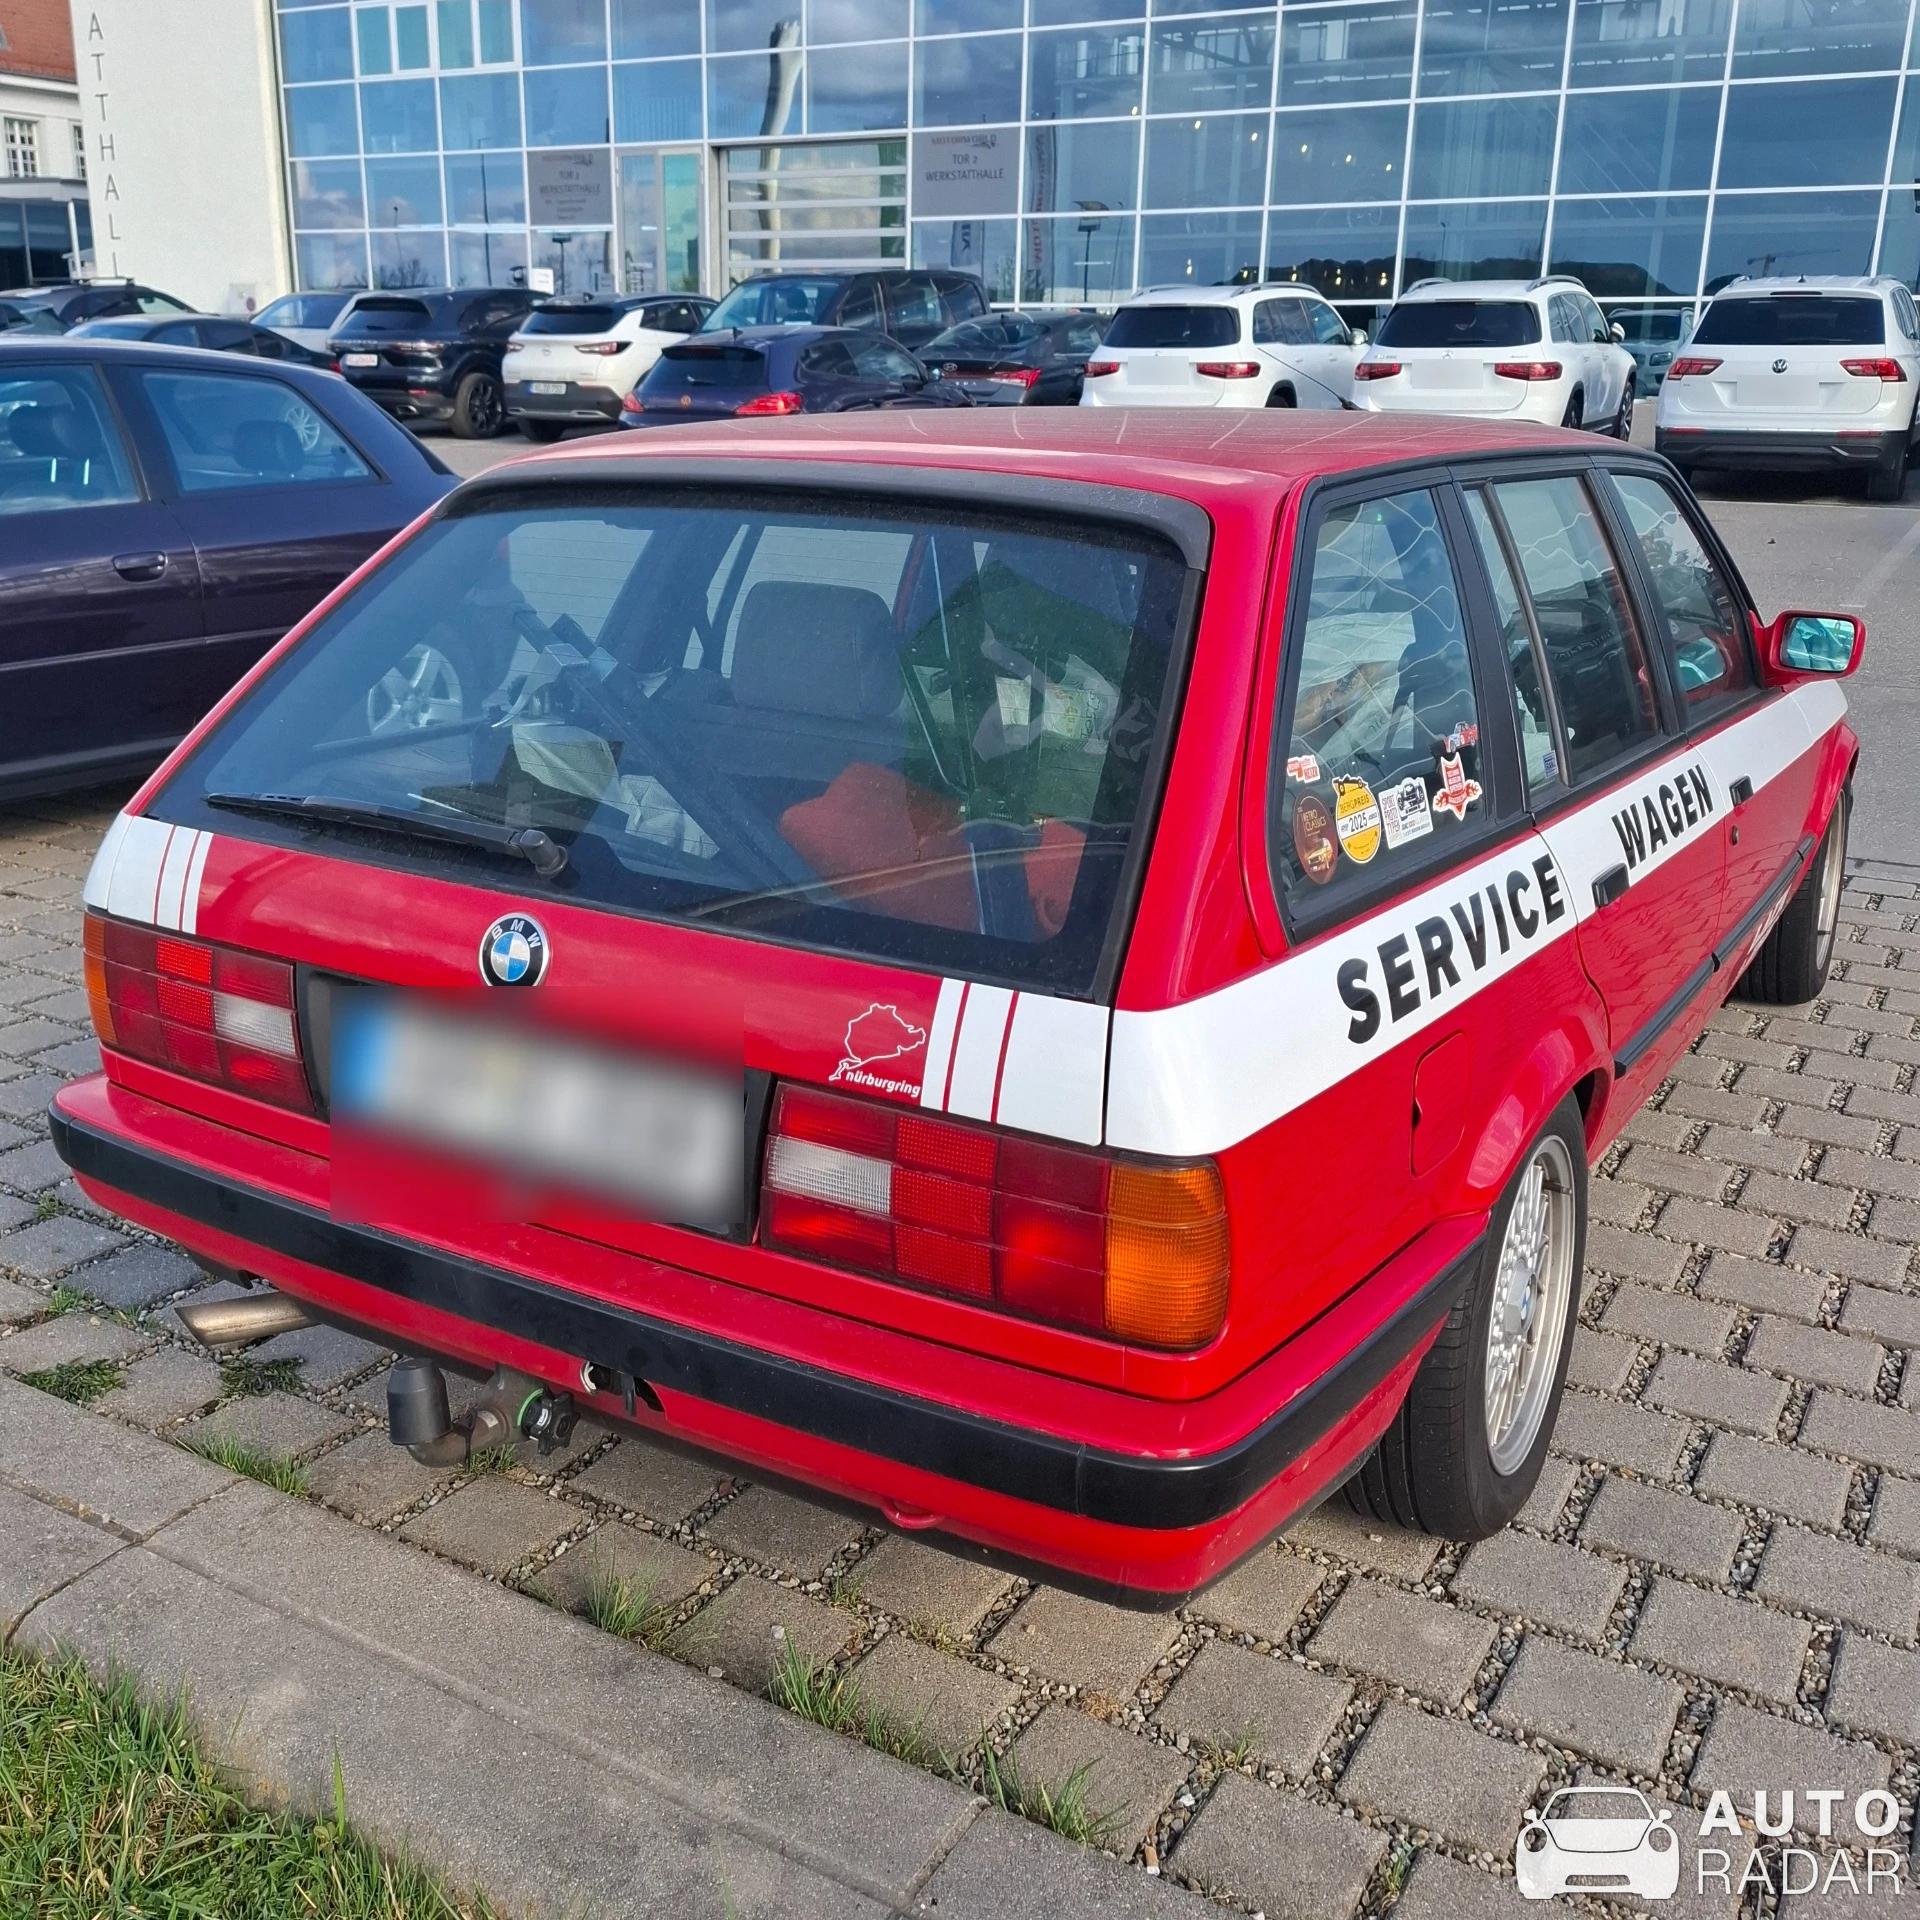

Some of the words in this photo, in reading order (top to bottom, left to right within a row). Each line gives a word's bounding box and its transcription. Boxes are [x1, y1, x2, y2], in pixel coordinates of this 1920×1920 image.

[952, 153, 970, 165] TOR
[925, 167, 1004, 181] WERKSTATTHALLE
[1339, 794, 1370, 814] BERGPREIS
[1303, 809, 1318, 823] RETRO
[1304, 816, 1327, 832] CLASSICS
[1349, 812, 1368, 833] 2025
[1336, 853, 1566, 1045] SERVICE
[1611, 764, 1714, 870] WAGEN
[491, 919, 542, 948] BMW
[845, 1069, 921, 1098] nürburgring
